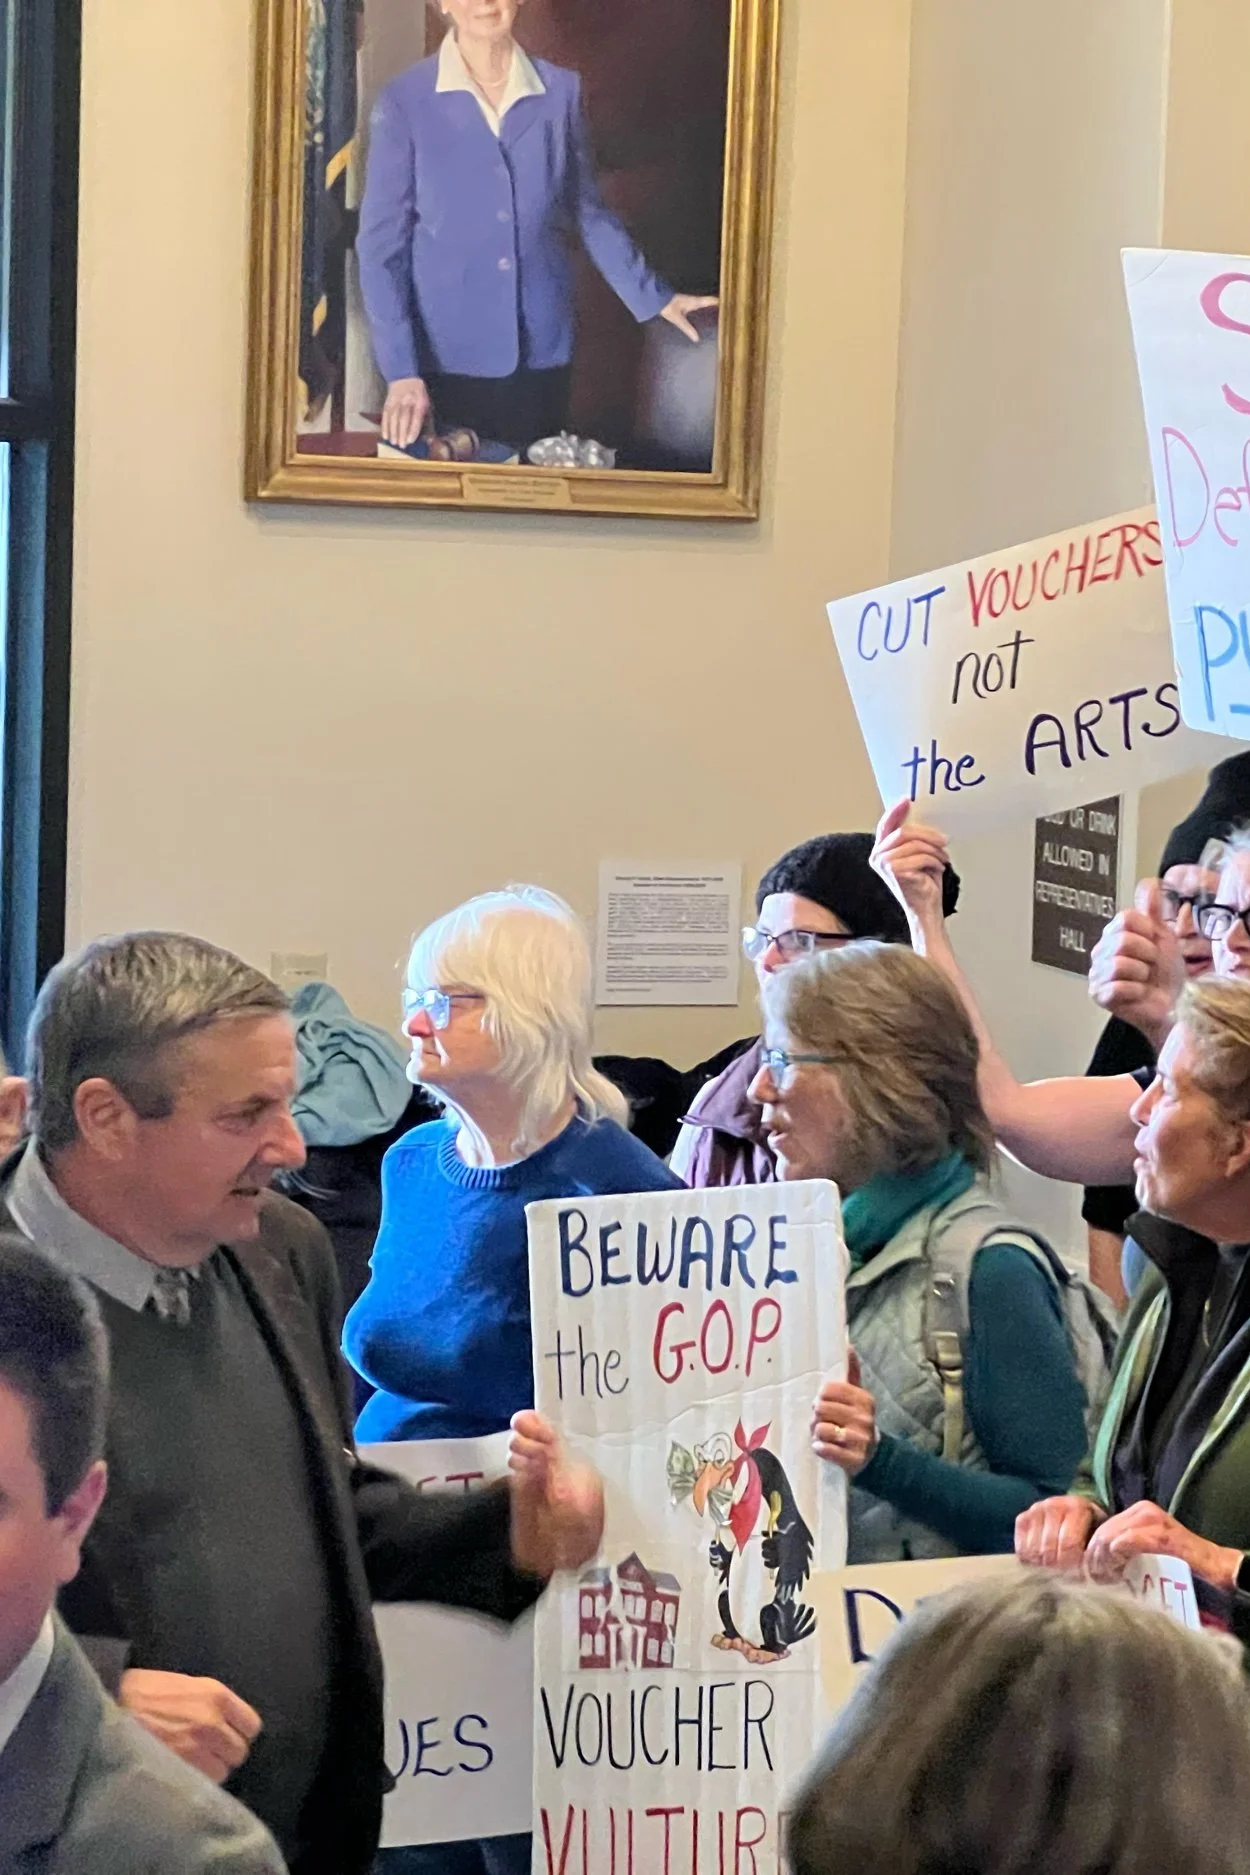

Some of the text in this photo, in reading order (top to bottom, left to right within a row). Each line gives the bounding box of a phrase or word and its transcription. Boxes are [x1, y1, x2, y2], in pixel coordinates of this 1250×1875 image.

[857, 520, 1163, 661] CUT VOUCHERS
[952, 630, 1035, 705] not
[903, 682, 1180, 801] the ARTS
[1043, 842, 1110, 875] ALLOWED IN
[1059, 926, 1086, 952] HALL
[558, 1208, 798, 1297] BEWARE
[545, 1324, 629, 1399] the
[541, 1679, 774, 1772] VOUCHER
